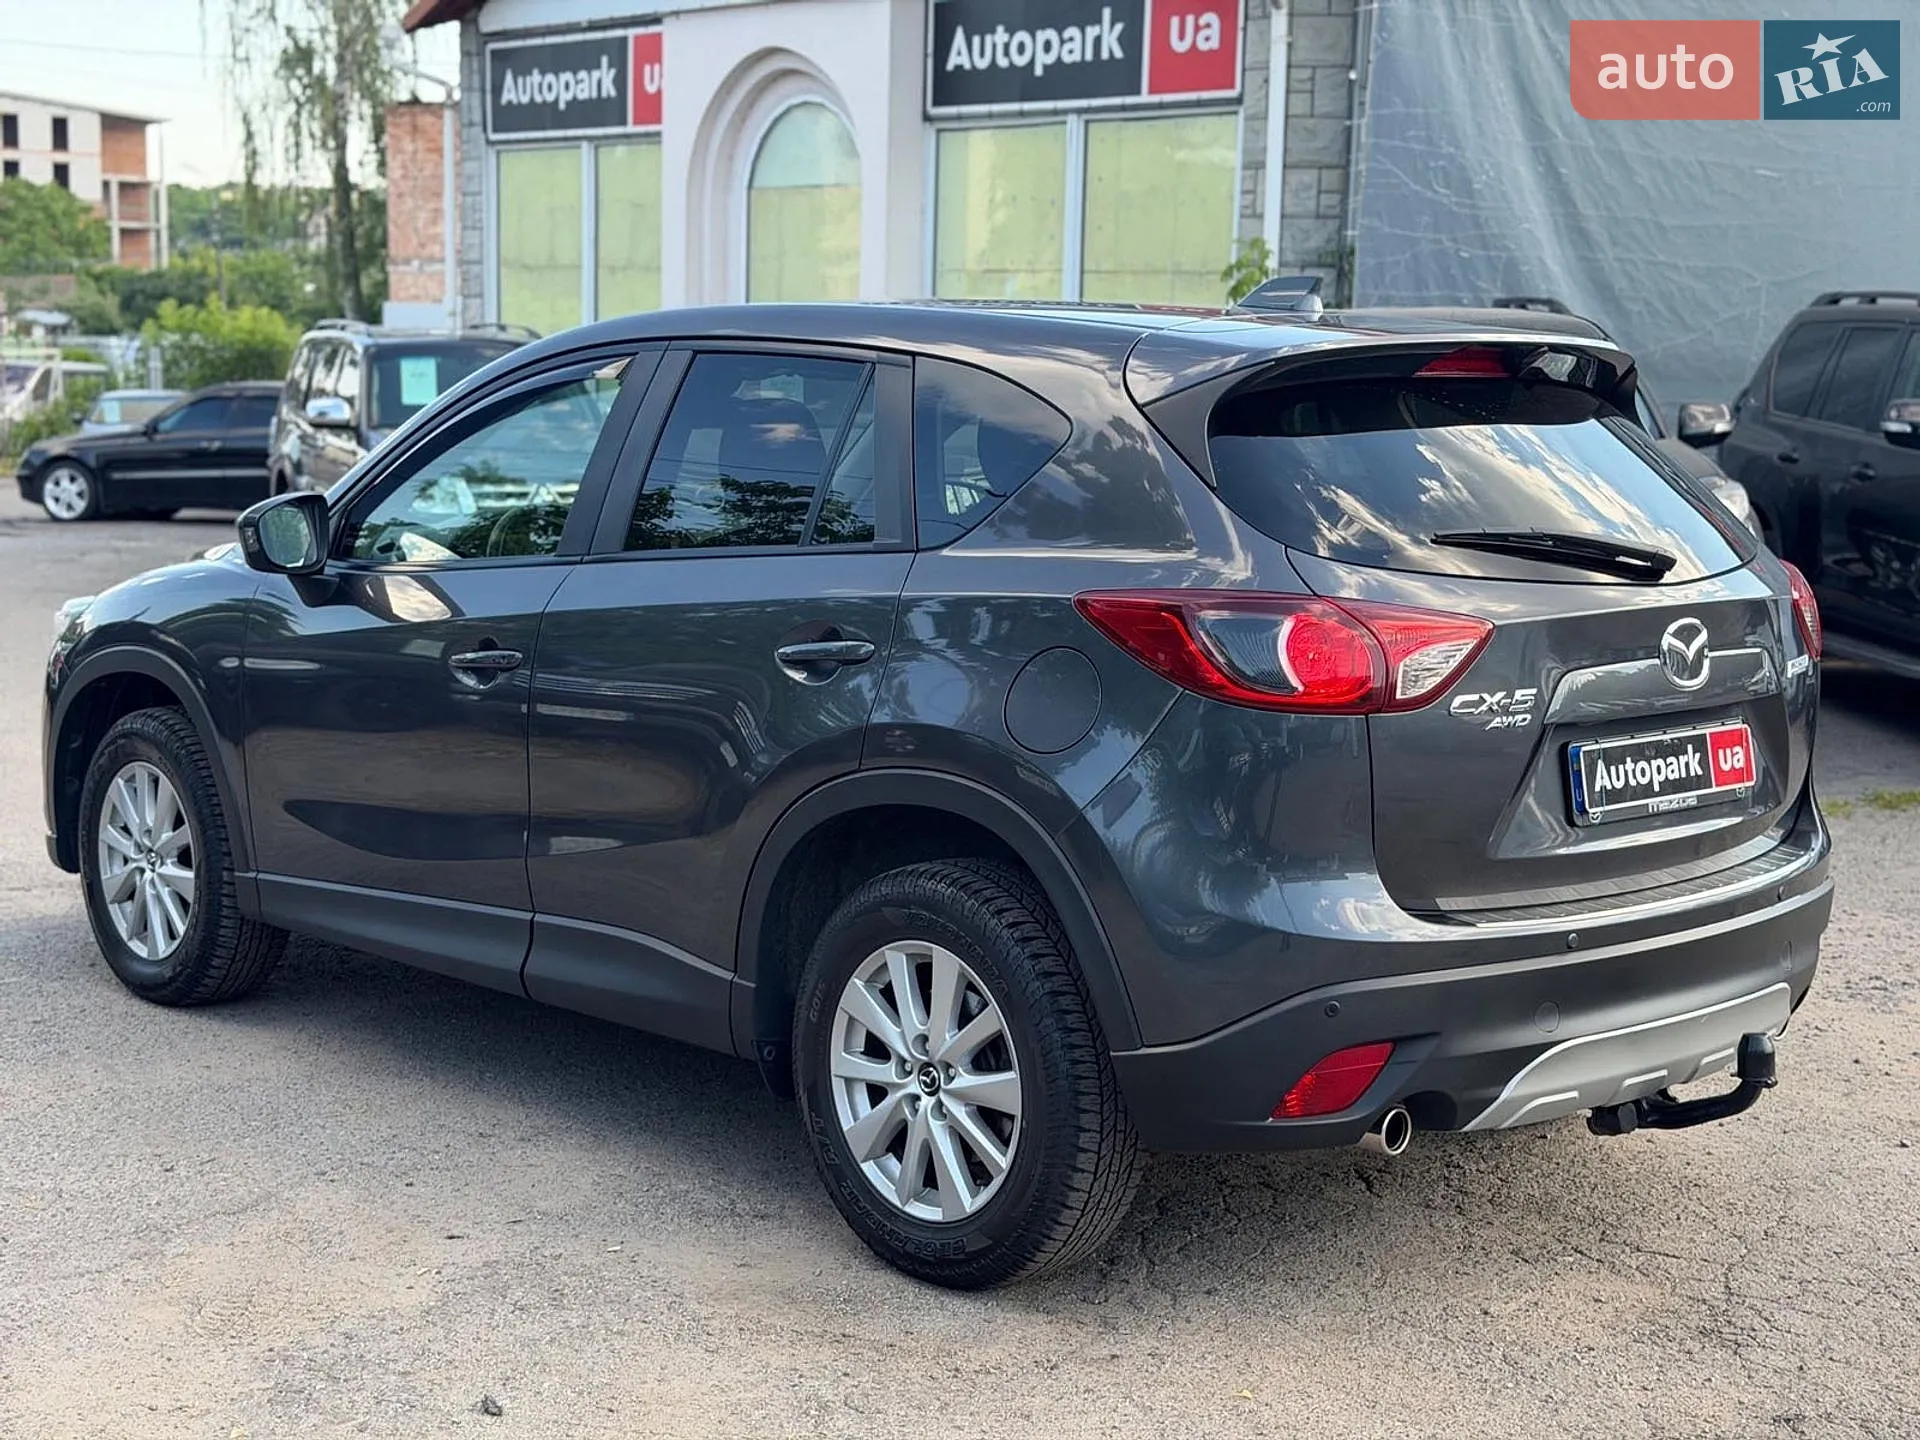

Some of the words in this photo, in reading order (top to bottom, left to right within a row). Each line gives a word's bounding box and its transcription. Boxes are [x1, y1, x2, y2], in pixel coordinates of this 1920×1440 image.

[946, 6, 1125, 77] Autopark
[1168, 11, 1222, 53] ua
[500, 54, 618, 111] Autopark
[643, 62, 663, 94] u
[1450, 687, 1538, 715] CX-5
[1485, 713, 1532, 731] AWD
[1594, 744, 1704, 792] Autopark
[1718, 745, 1744, 771] ua
